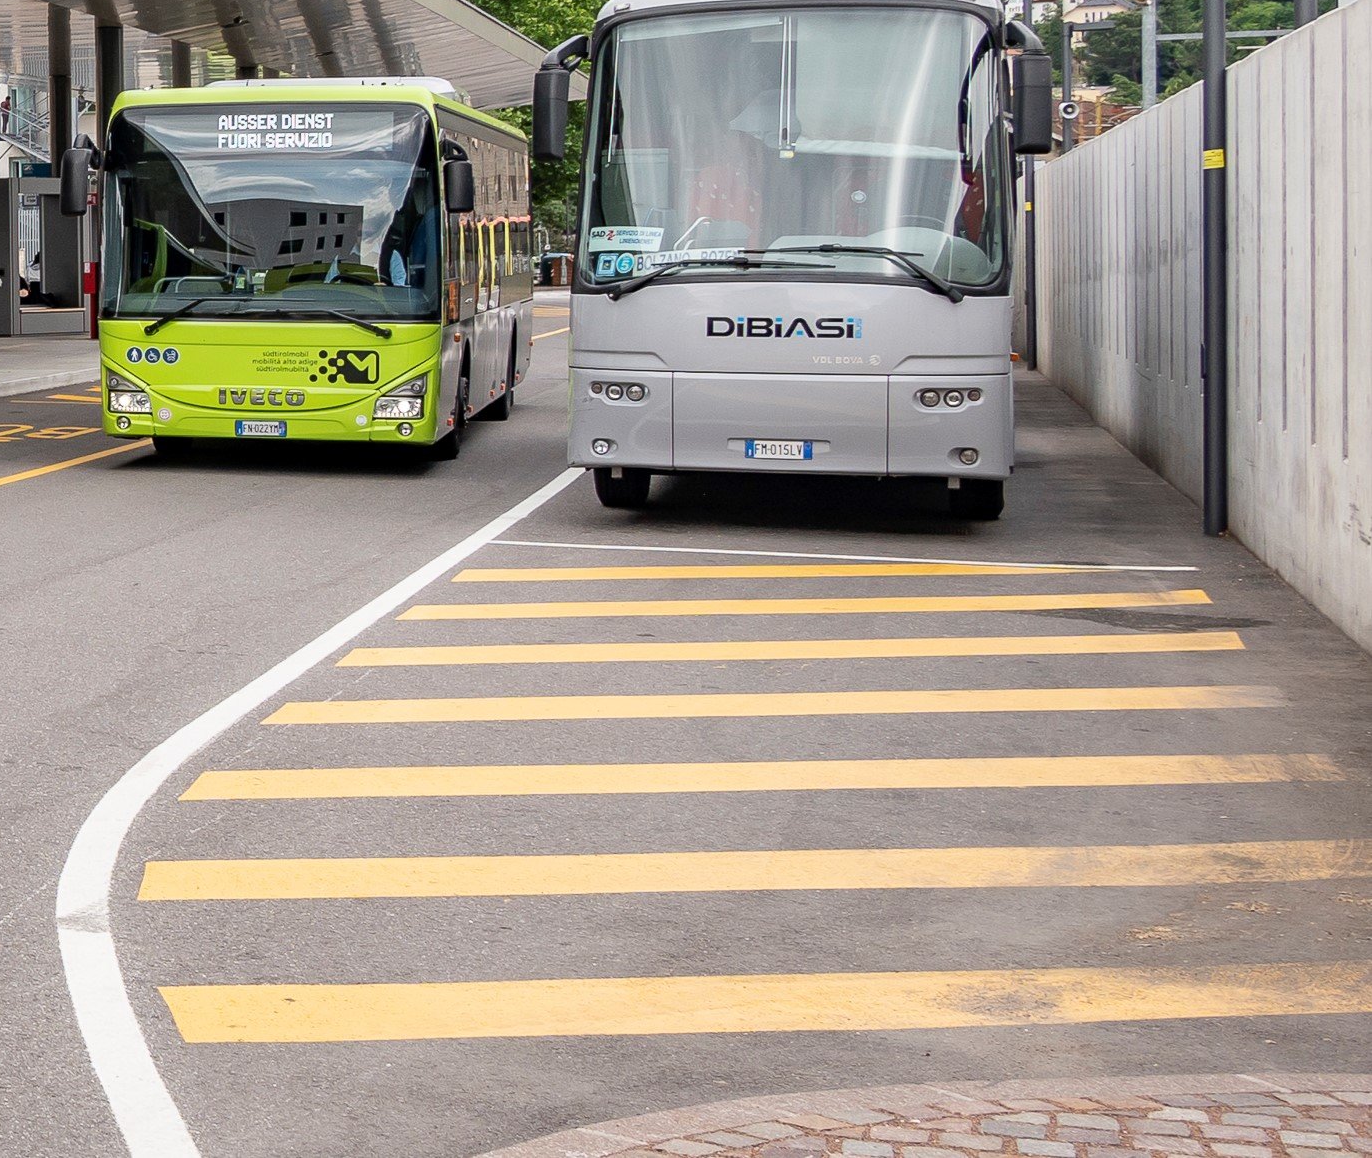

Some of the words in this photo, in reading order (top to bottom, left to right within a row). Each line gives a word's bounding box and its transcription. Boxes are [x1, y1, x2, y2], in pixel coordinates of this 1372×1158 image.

[218, 115, 277, 130] AUSSER
[281, 113, 334, 129] DIENST
[218, 133, 261, 148] FUORI
[265, 132, 333, 148] SERVIZIO
[299, 358, 318, 366] adige
[218, 387, 306, 406] IVECO
